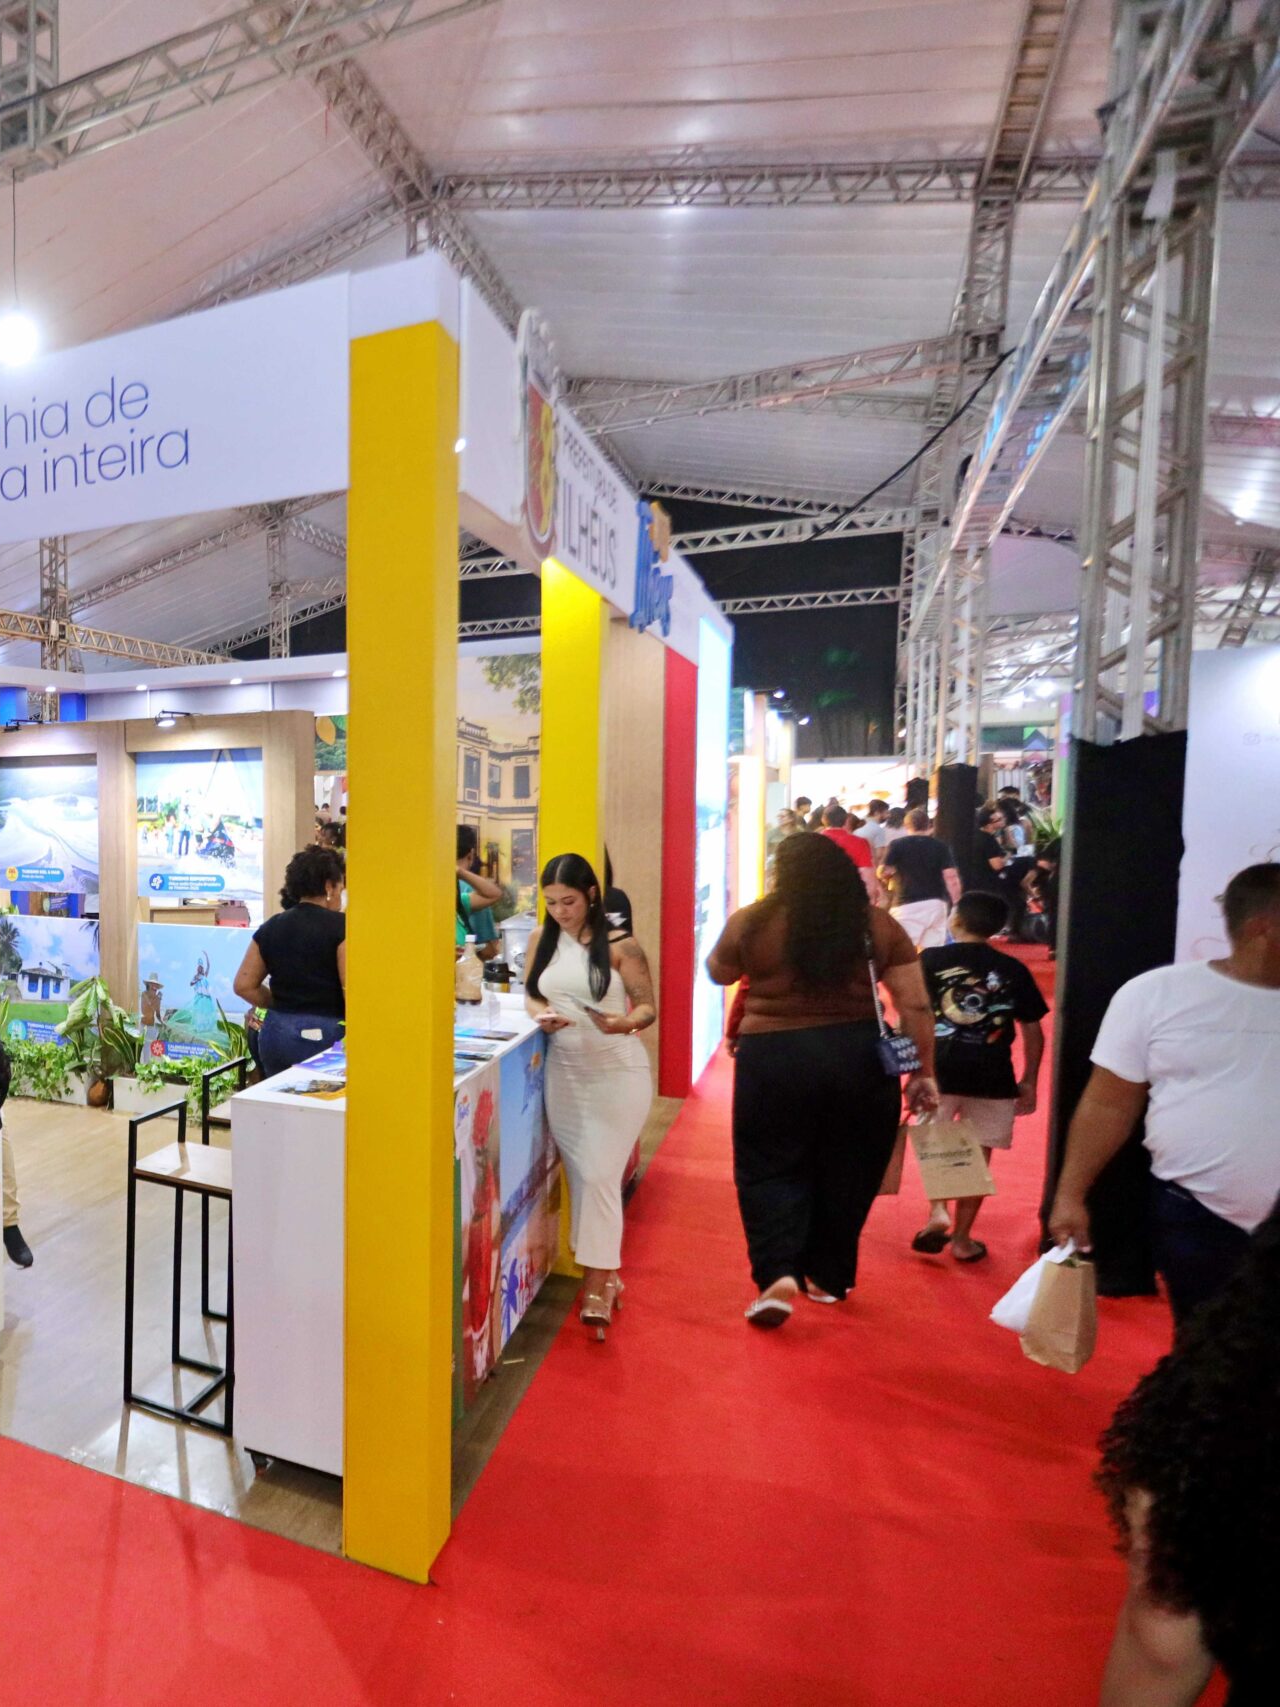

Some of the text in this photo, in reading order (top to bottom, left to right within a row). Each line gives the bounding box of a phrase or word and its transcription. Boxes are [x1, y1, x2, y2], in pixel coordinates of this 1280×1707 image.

[85, 376, 149, 428] de
[43, 428, 189, 494] inteira
[563, 478, 617, 590] ILHÉUS
